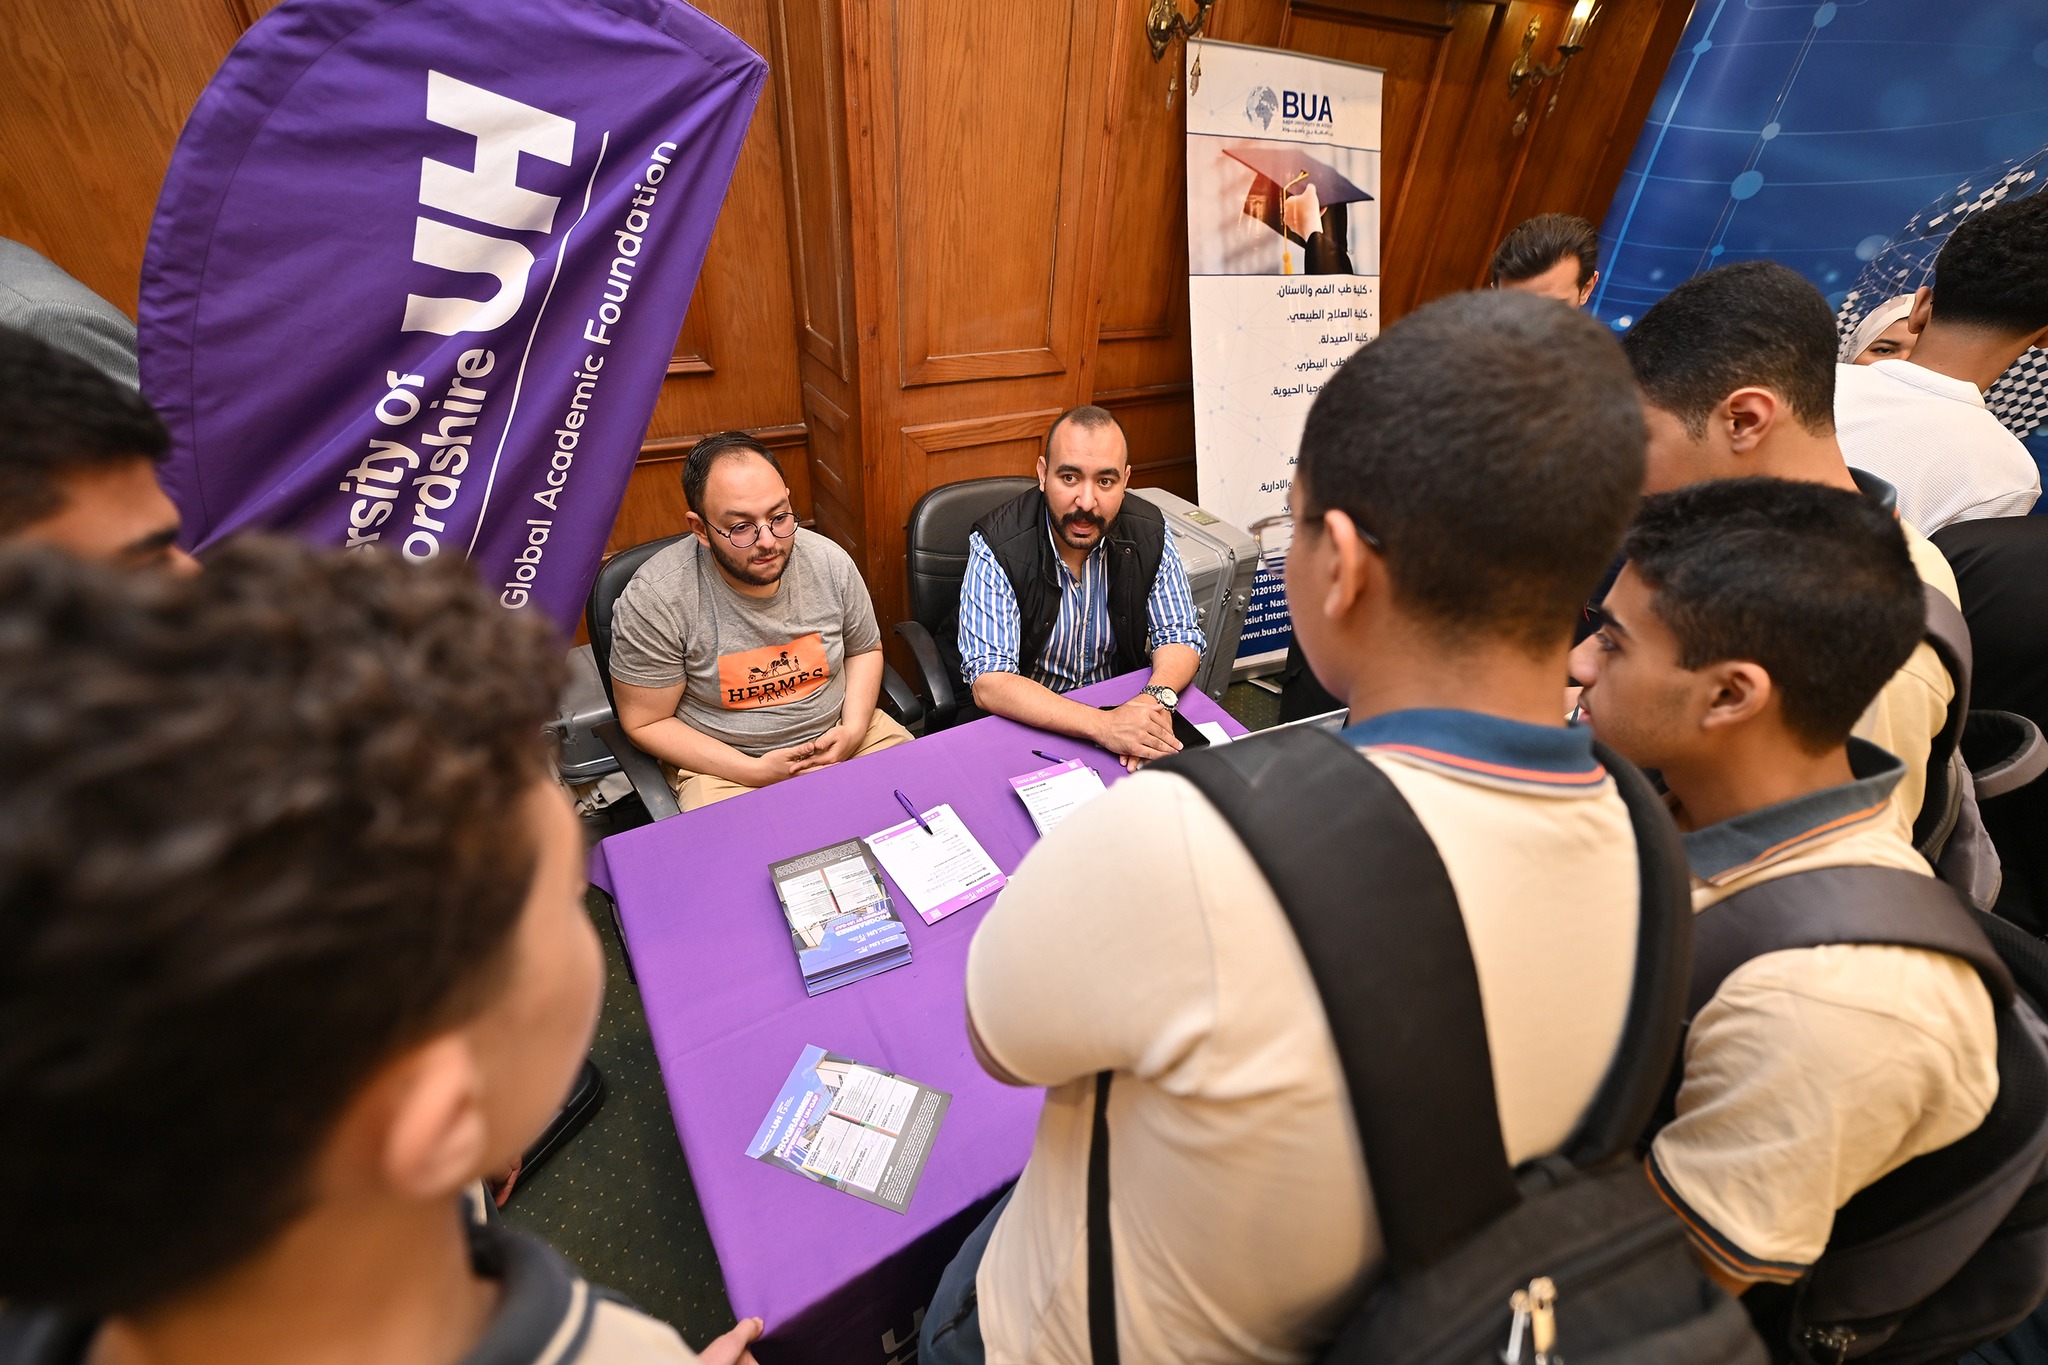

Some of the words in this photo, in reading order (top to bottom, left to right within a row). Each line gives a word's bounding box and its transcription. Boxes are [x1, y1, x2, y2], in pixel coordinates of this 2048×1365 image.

[1283, 91, 1333, 123] BUA
[400, 69, 577, 336] UH
[1315, 284, 1335, 297] الفم
[1338, 284, 1352, 296] طب
[1354, 285, 1368, 297] كلية
[1327, 308, 1353, 322] العلاج
[1354, 309, 1368, 321] كلية
[500, 519, 552, 610] Global
[533, 355, 605, 511] Academic
[584, 141, 677, 345] Foundation
[375, 370, 425, 425] of
[340, 438, 420, 553] rsity
[758, 685, 797, 704] PARIS
[834, 912, 891, 937] PROGRAMMES
[771, 1114, 784, 1130] UH
[773, 1089, 814, 1158] PROGRAMMES
[783, 1126, 803, 1159] OFFERED
[798, 1117, 807, 1128] BY
[803, 1094, 820, 1119] UH-GAF
